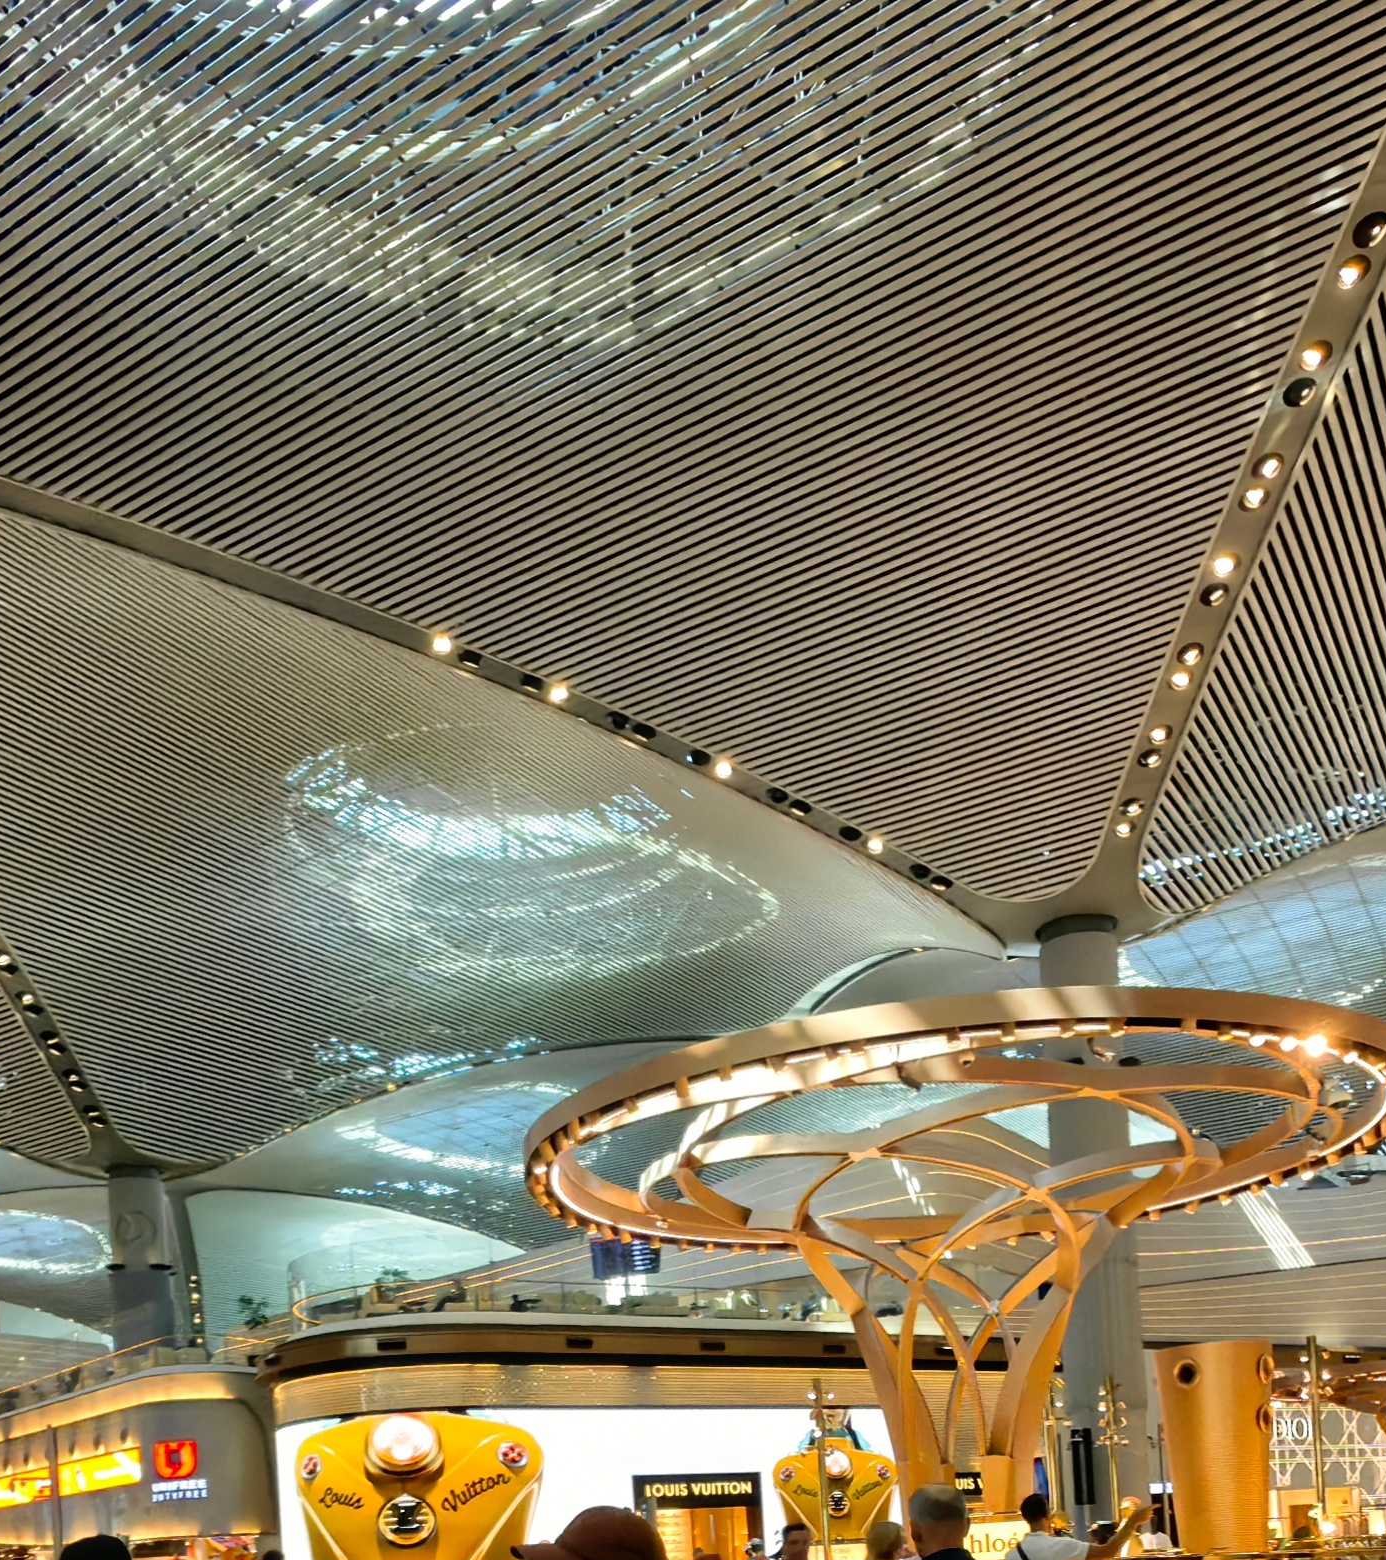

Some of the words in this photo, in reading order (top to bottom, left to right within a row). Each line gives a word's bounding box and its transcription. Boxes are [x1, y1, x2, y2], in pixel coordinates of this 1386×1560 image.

[151, 1479, 208, 1492] UNIFREE
[319, 1487, 365, 1509] Louis
[441, 1473, 511, 1512] Vuitton
[645, 1484, 689, 1498] LOUIS
[691, 1481, 753, 1496] VUITTON
[967, 1532, 1020, 1554] hloé
